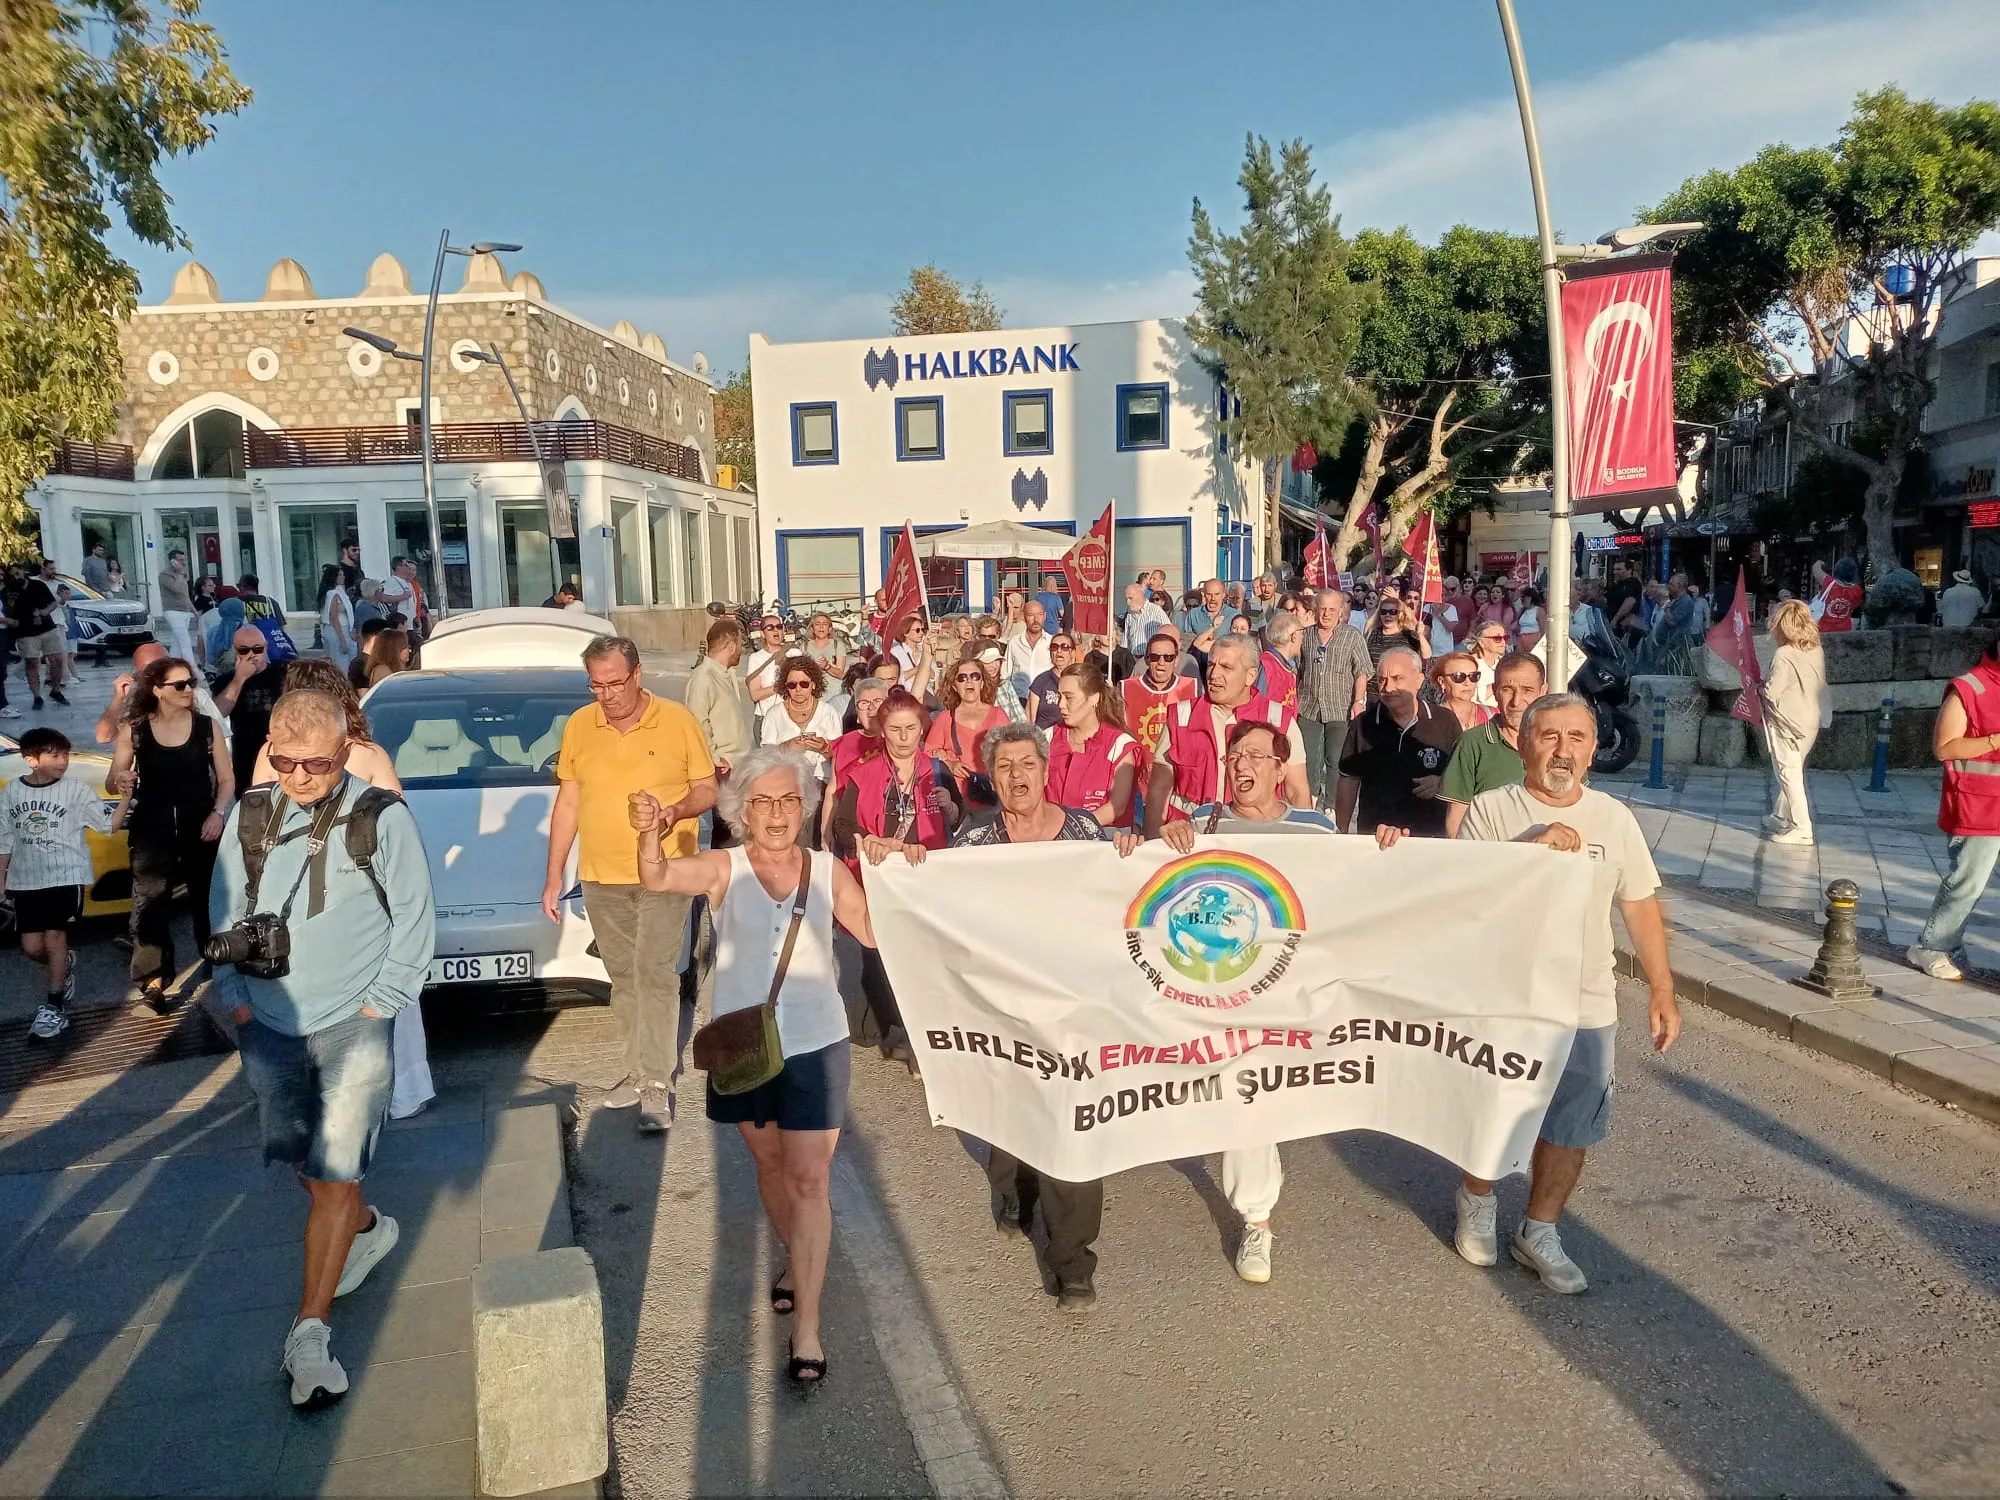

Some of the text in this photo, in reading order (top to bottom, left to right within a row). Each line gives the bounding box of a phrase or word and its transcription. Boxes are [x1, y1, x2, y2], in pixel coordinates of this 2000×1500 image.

[905, 342, 1081, 382] HALKBANK
[1149, 724, 1163, 735] EM
[9, 800, 68, 819] BROOKLYN
[443, 959, 482, 981] COS
[494, 956, 529, 977] 129
[1126, 930, 1165, 992] BİRLEŞİK
[1163, 984, 1252, 1010] EMEKLİLER
[926, 1018, 1543, 1082] BİRLEŞİK EMEKLİLER SENDİKASI
[1074, 1055, 1375, 1132] BODRUM ŞUBESİ
